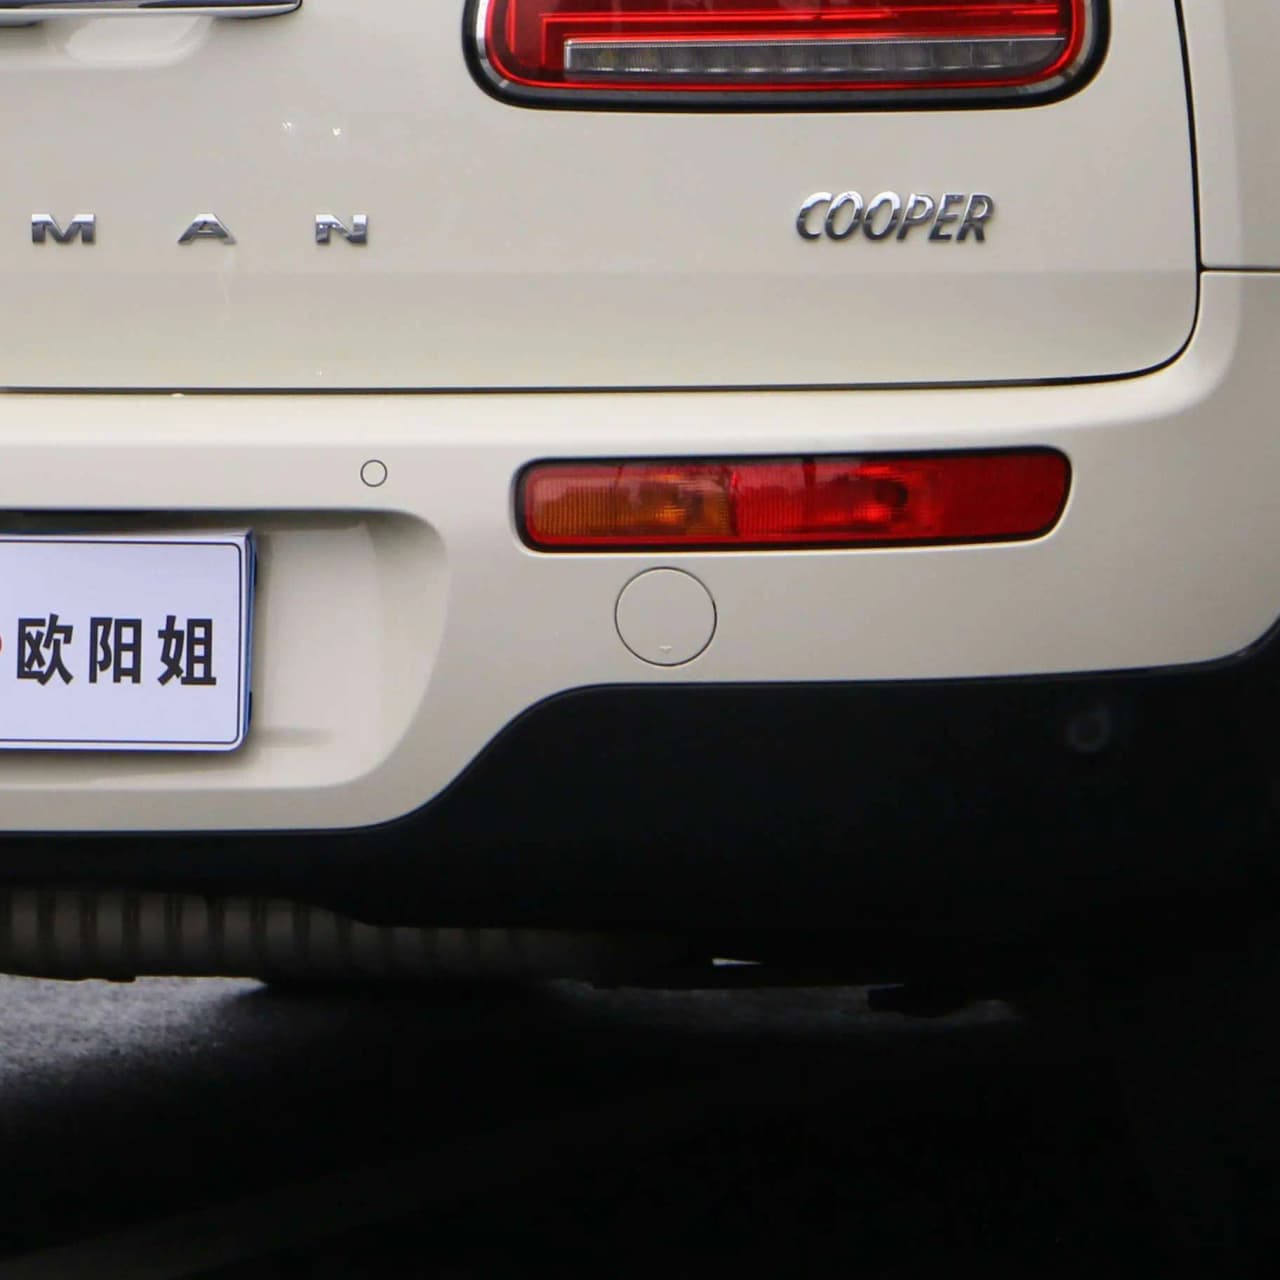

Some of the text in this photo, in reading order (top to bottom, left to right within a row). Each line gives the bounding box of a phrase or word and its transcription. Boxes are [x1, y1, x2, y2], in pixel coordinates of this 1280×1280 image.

[796, 191, 994, 243] COOPER
[17, 612, 216, 686] 欧阳姐
